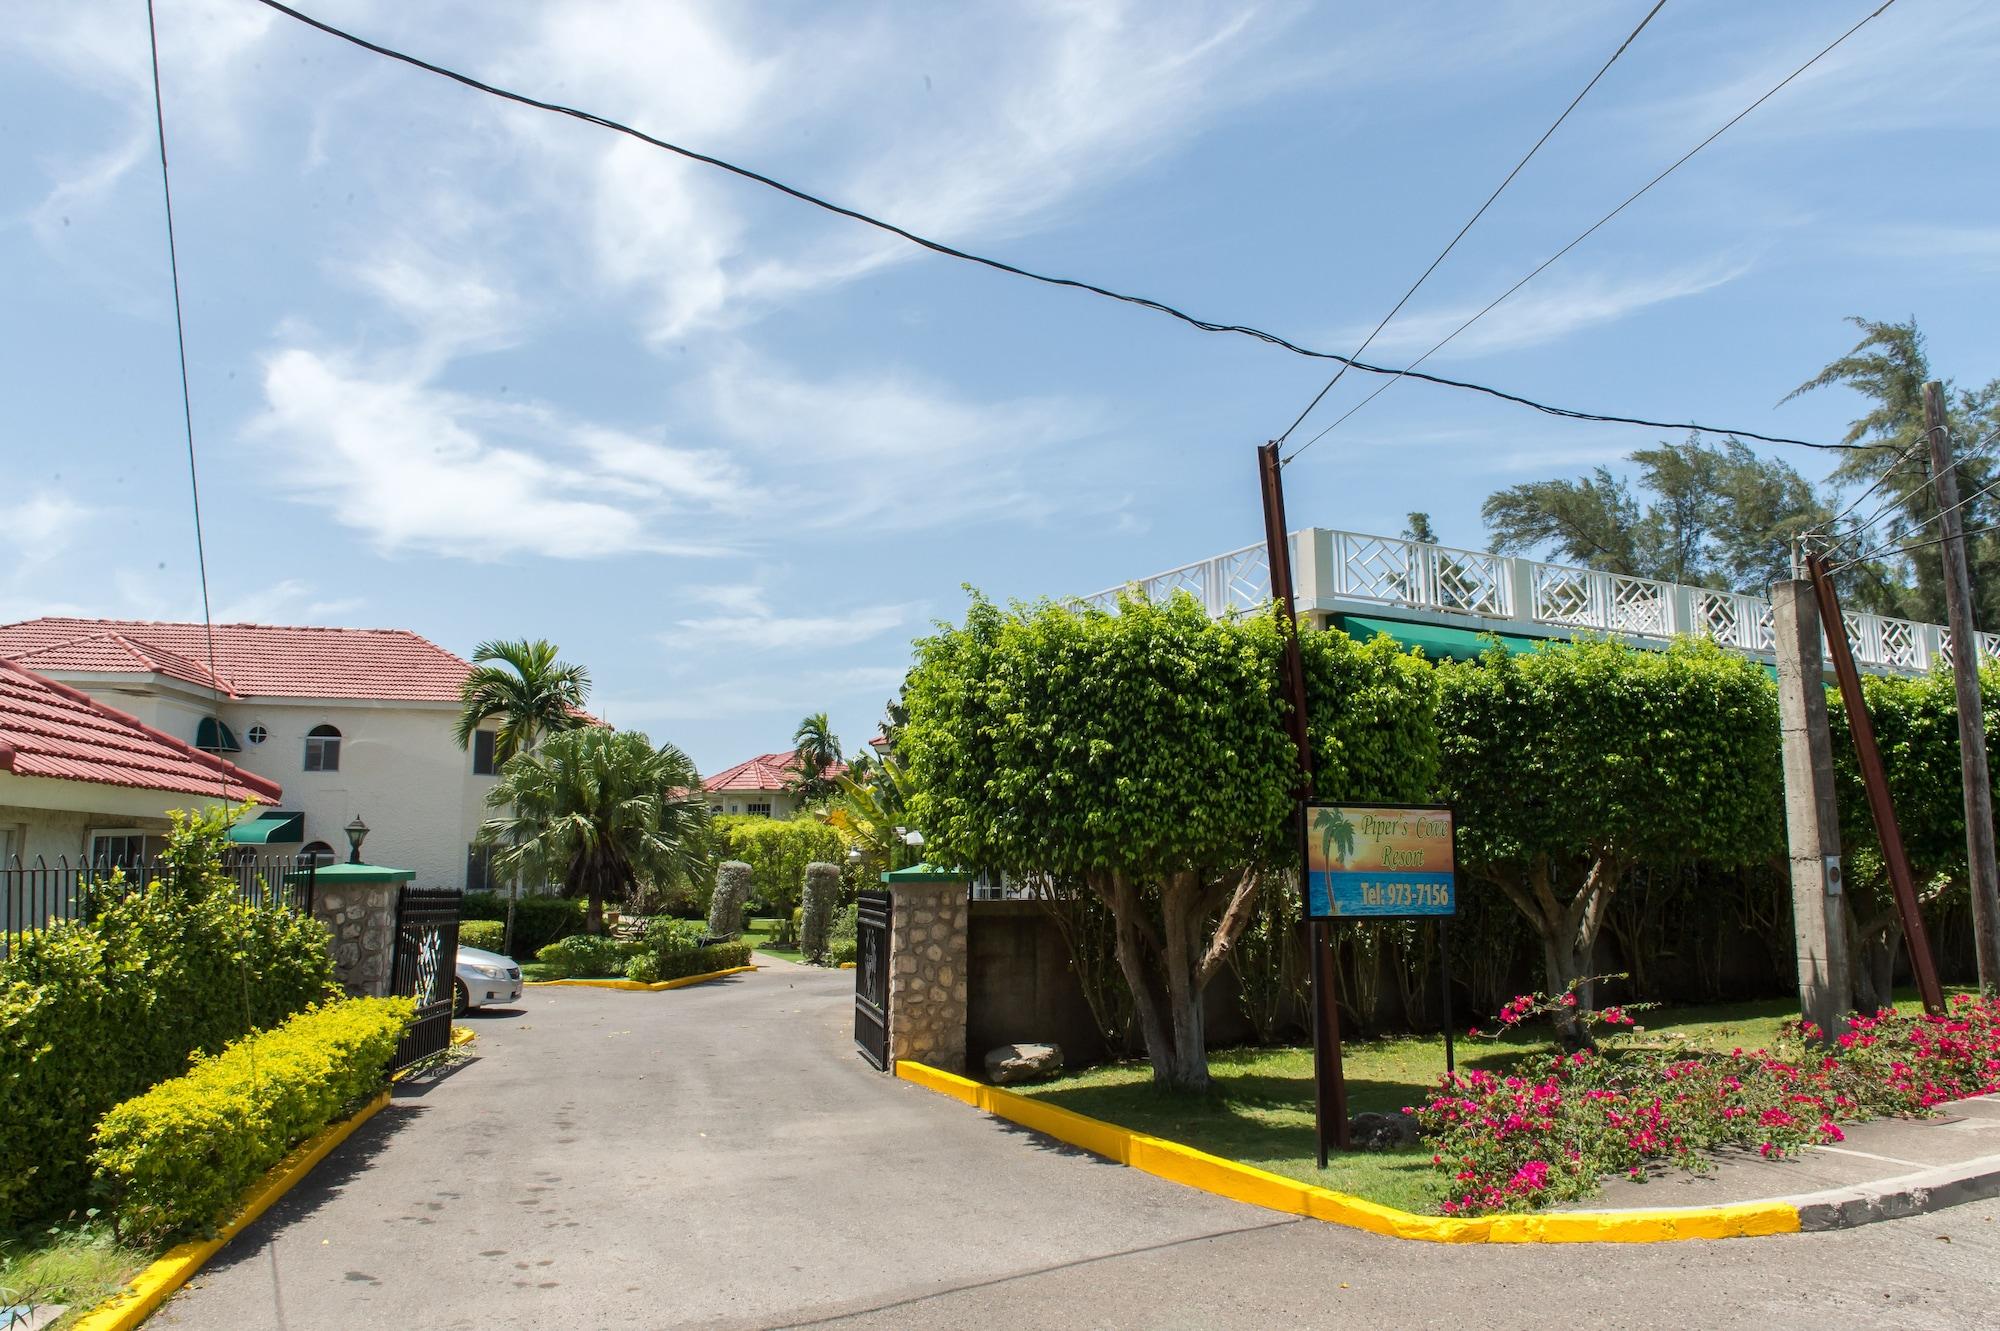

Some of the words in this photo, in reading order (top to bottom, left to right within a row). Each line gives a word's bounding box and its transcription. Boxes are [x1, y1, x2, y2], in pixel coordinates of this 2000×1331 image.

[1361, 814, 1408, 842] Piper's
[1416, 816, 1448, 838] Cove
[1382, 845, 1424, 870] Resort
[1361, 882, 1385, 905] Tel:
[1387, 883, 1449, 906] 973-7156
